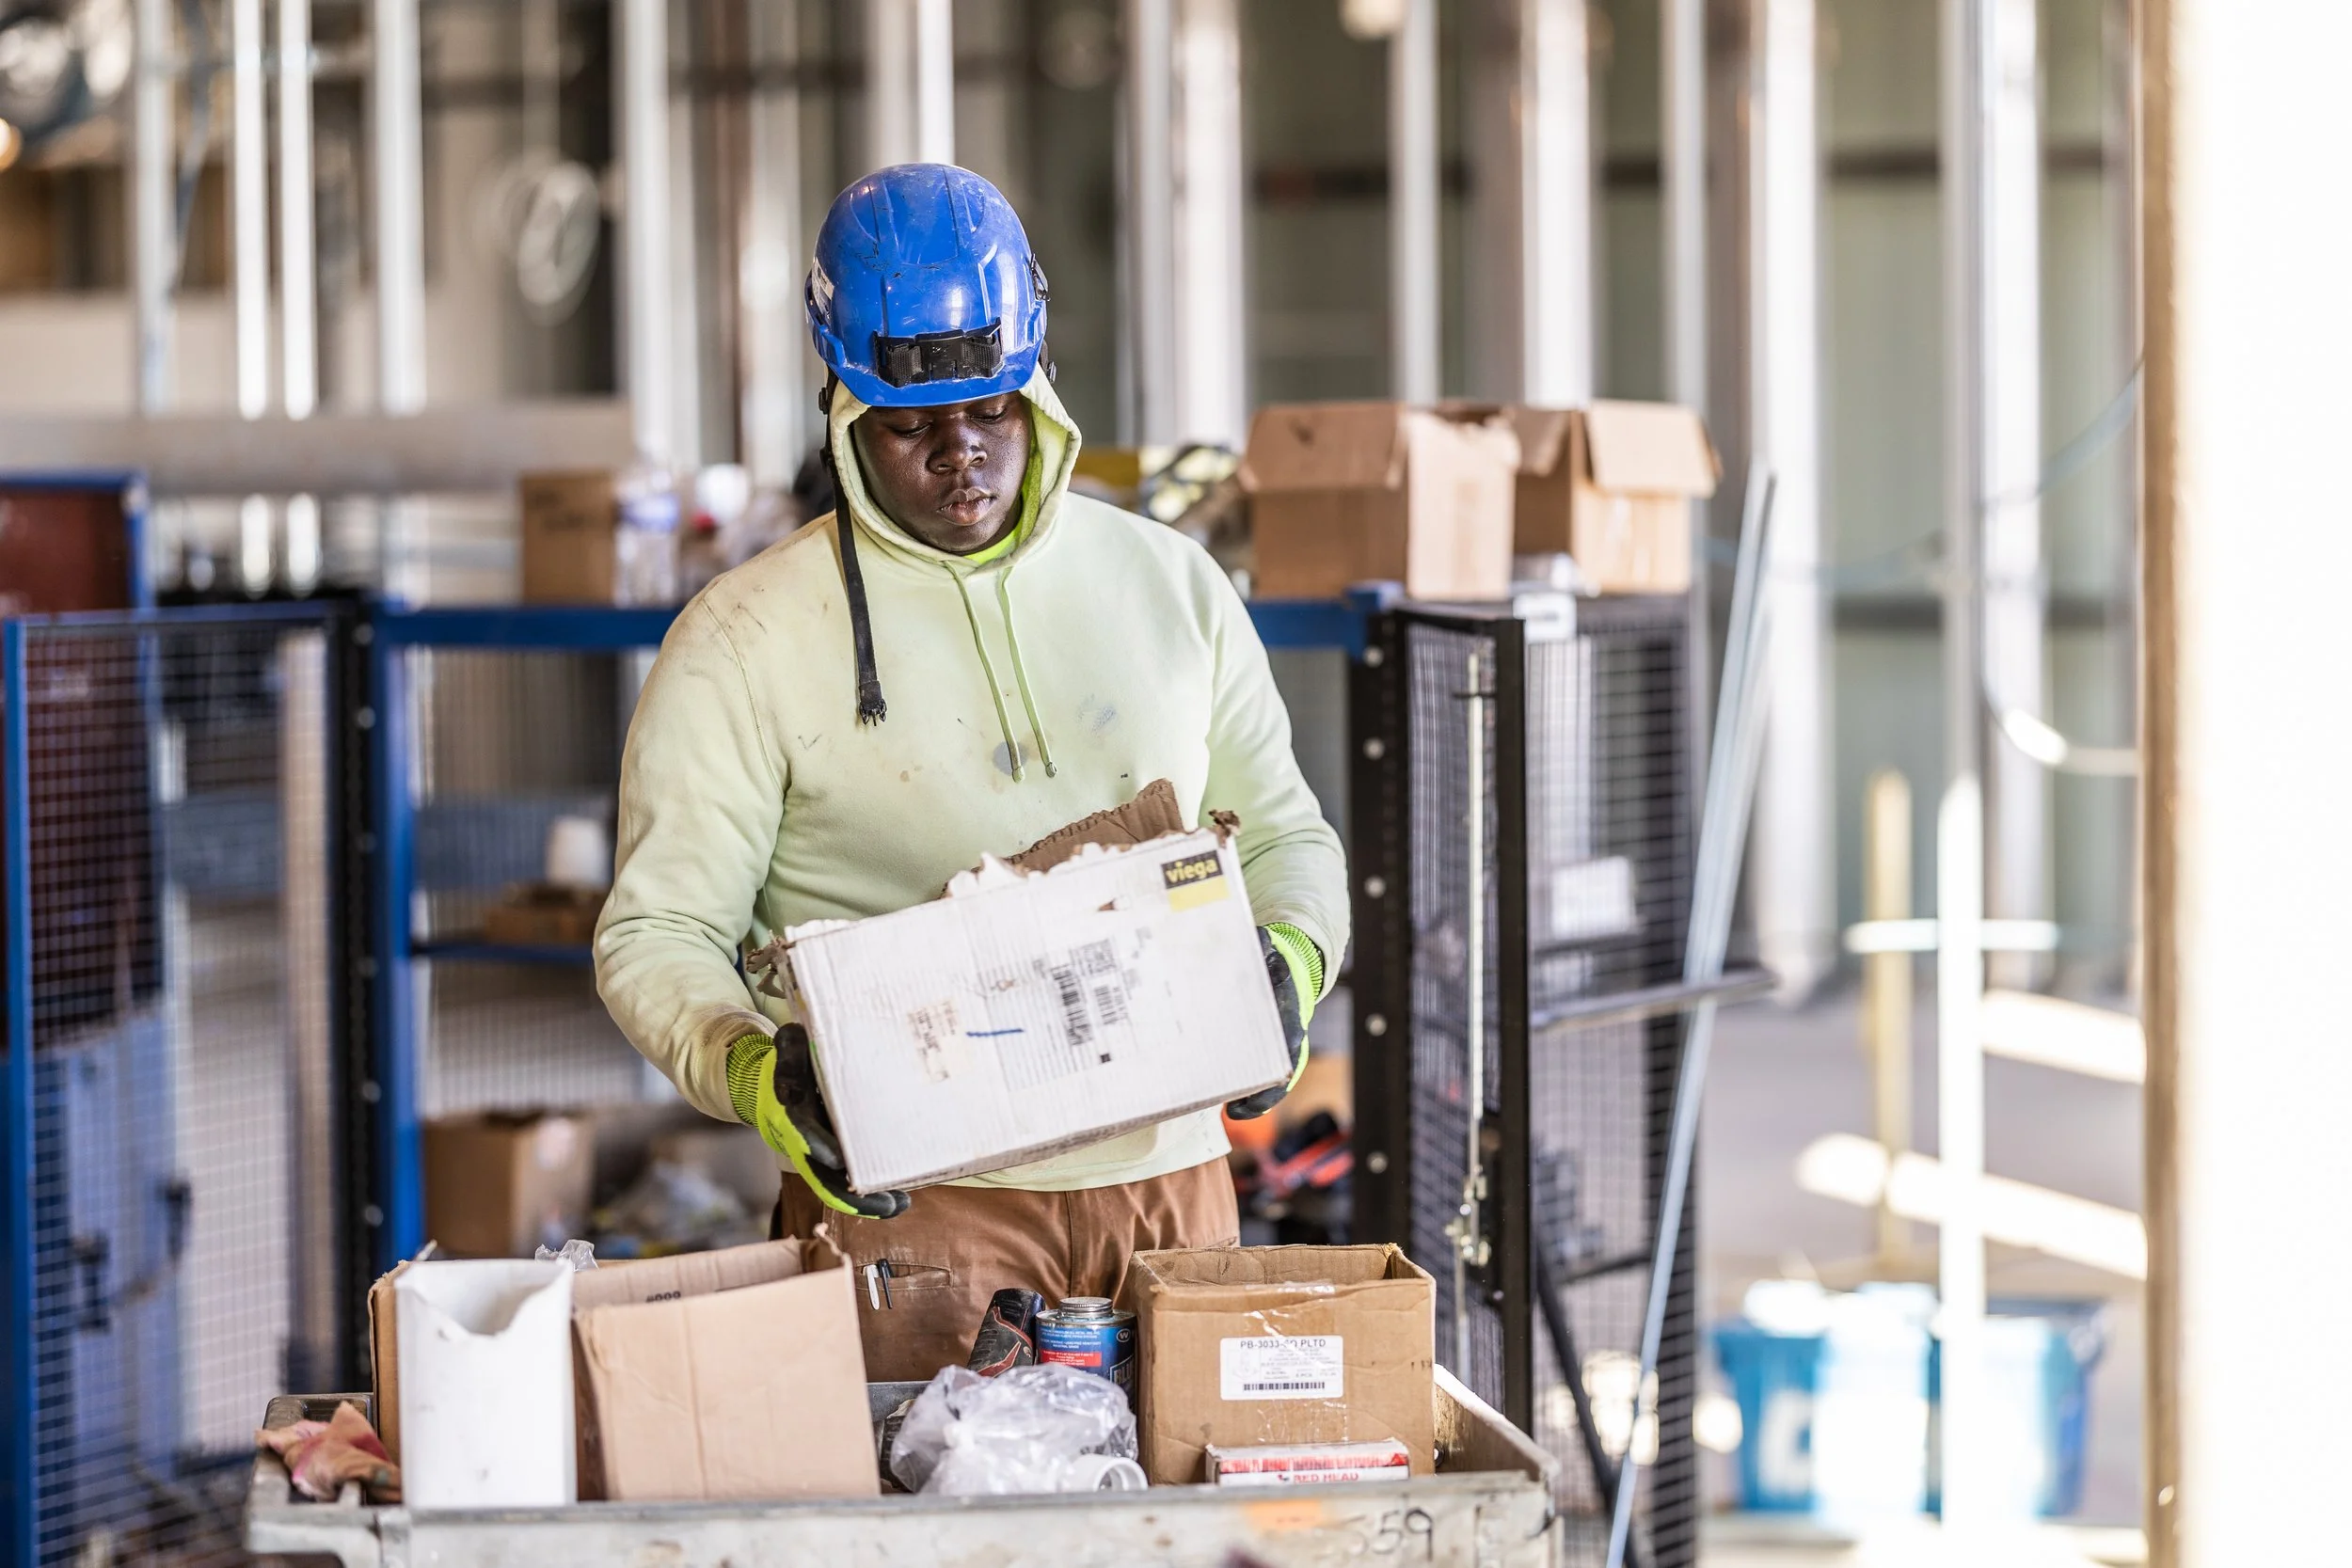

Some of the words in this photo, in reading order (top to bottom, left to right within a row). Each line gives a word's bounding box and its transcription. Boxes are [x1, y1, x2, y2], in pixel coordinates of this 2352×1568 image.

[1165, 858, 1218, 883] viega
[1300, 1338, 1327, 1347] PLTD
[1295, 1473, 1319, 1483] RED
[1324, 1471, 1359, 1482] HEAD
